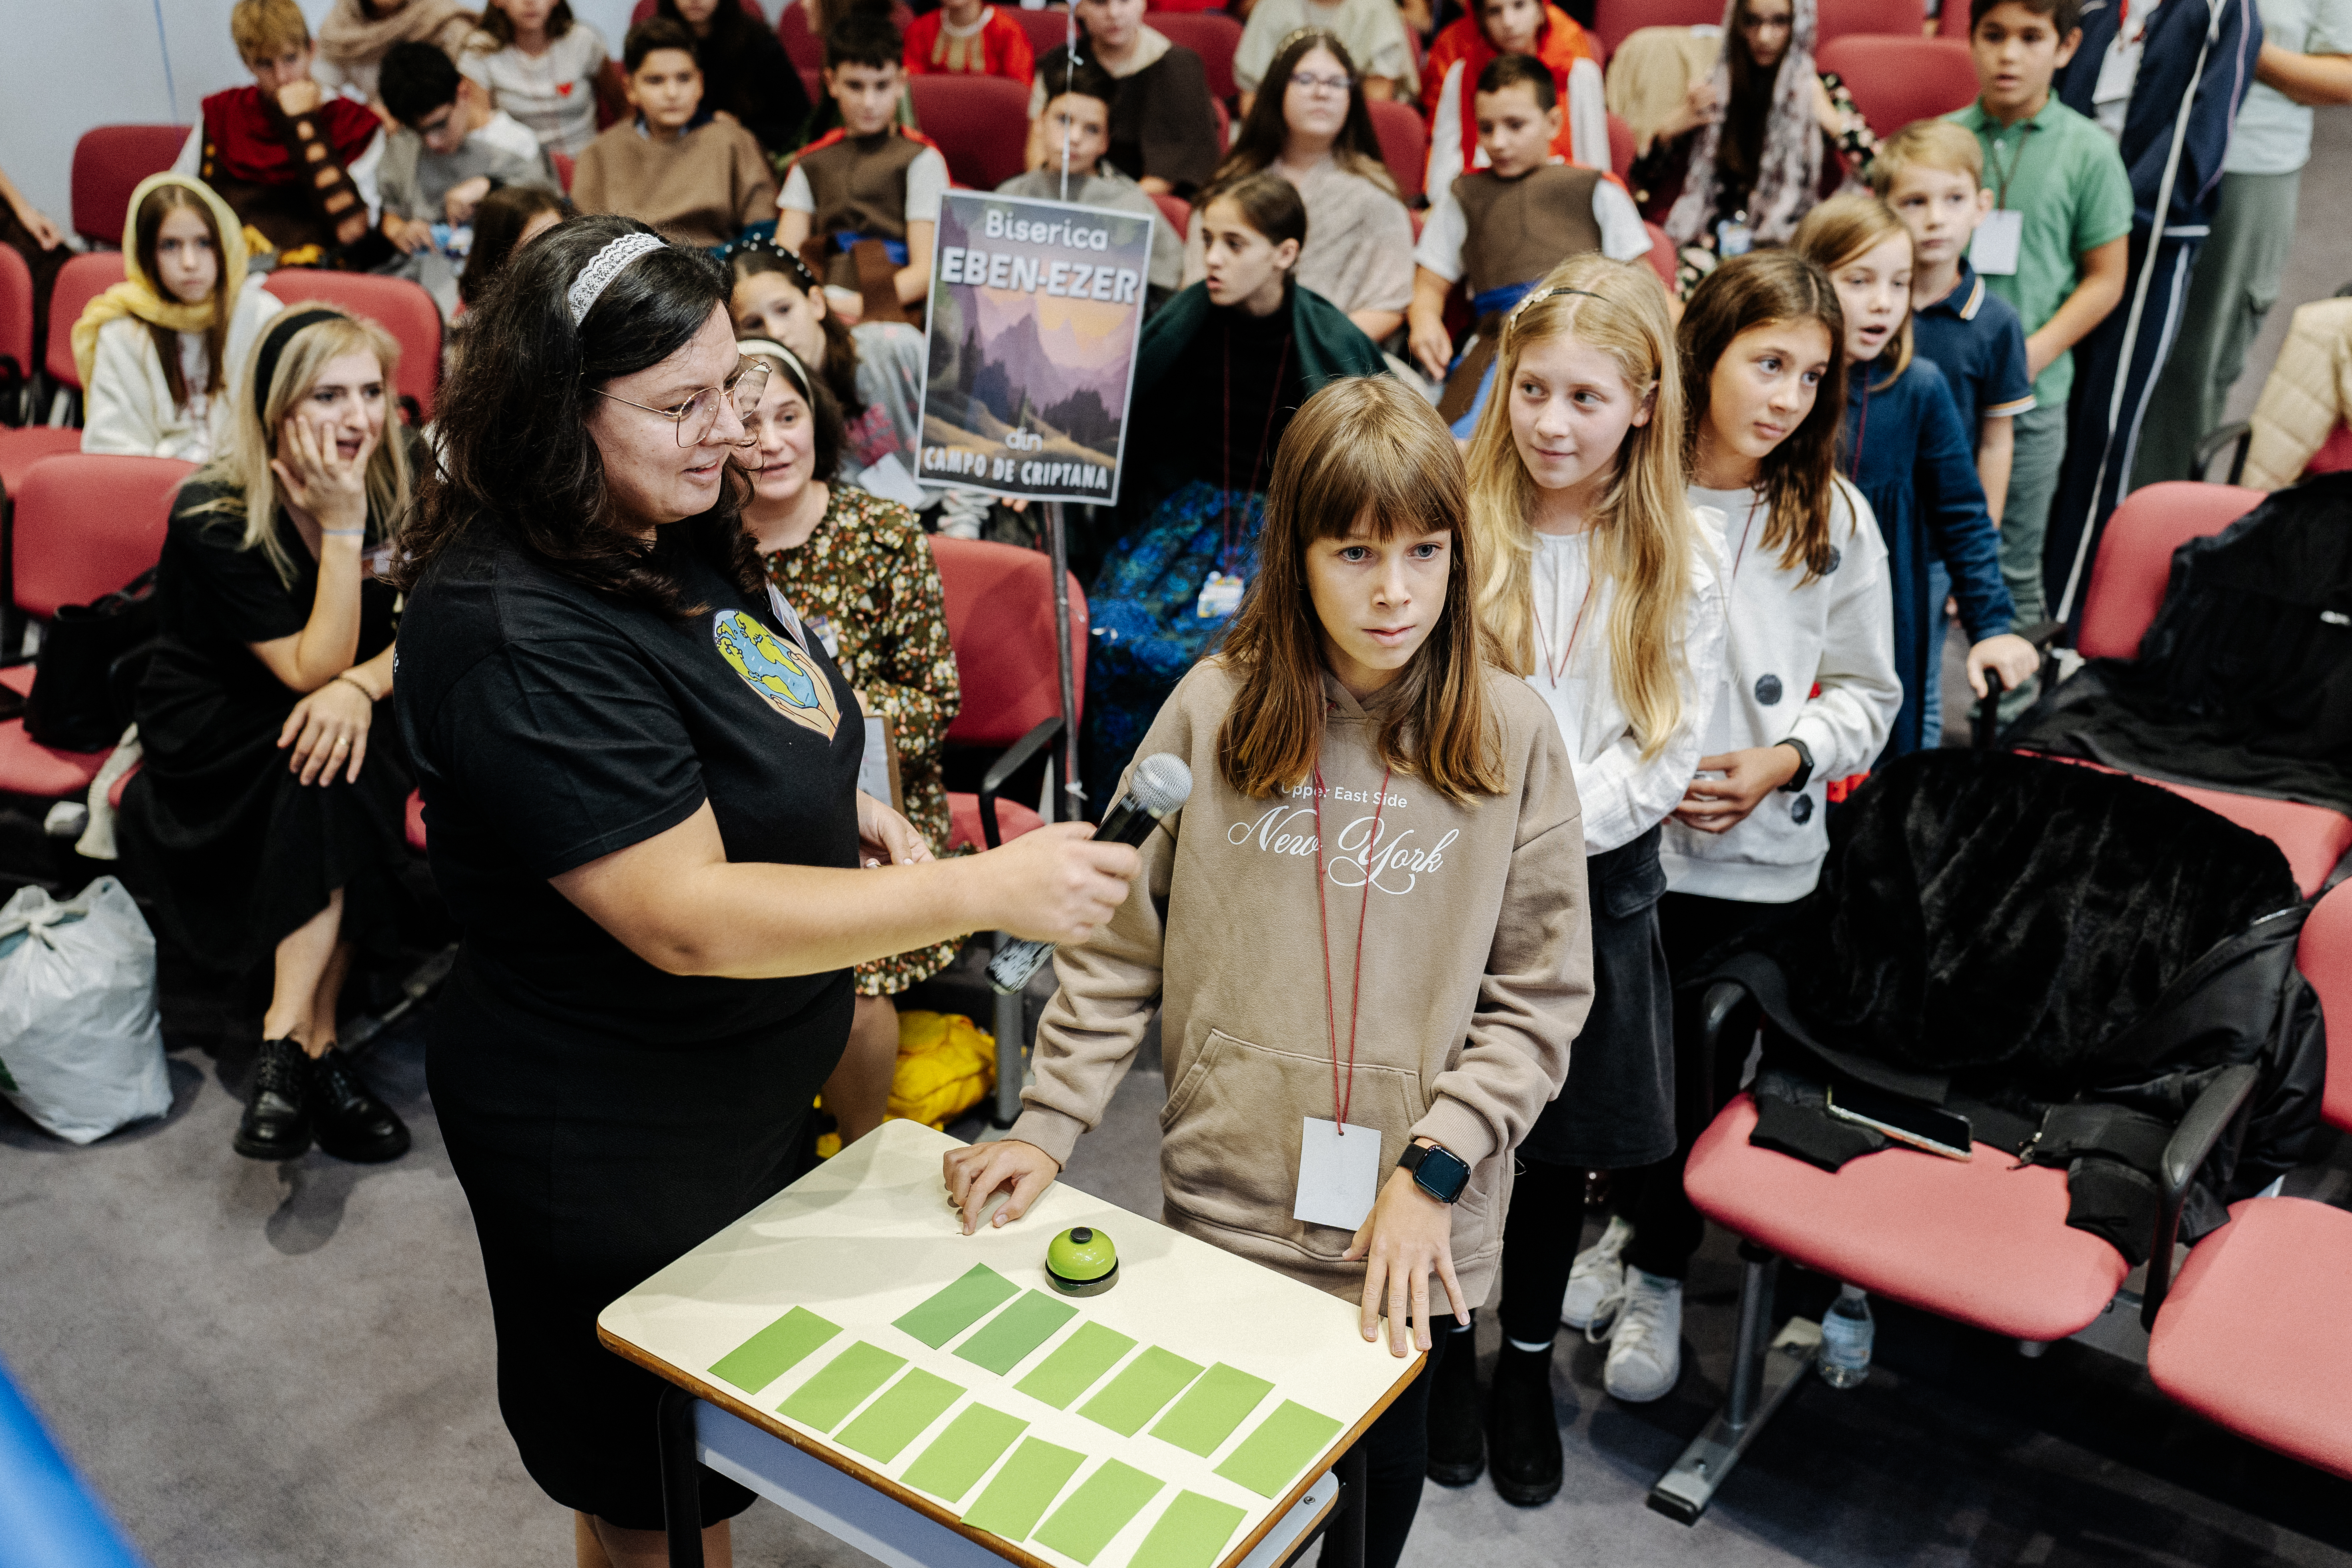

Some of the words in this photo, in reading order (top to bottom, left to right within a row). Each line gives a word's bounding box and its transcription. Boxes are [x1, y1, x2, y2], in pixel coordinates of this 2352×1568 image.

[985, 208, 1109, 252] Biserica
[940, 245, 1139, 304] EBEN-EZER
[1005, 426, 1043, 452] din
[924, 446, 987, 478] CAMPO
[992, 457, 1016, 483] DE
[1021, 460, 1108, 490] CRIPTANA
[1334, 786, 1368, 803] East
[1372, 791, 1407, 808] Side
[1228, 805, 1323, 856] New
[1328, 816, 1459, 895] York
